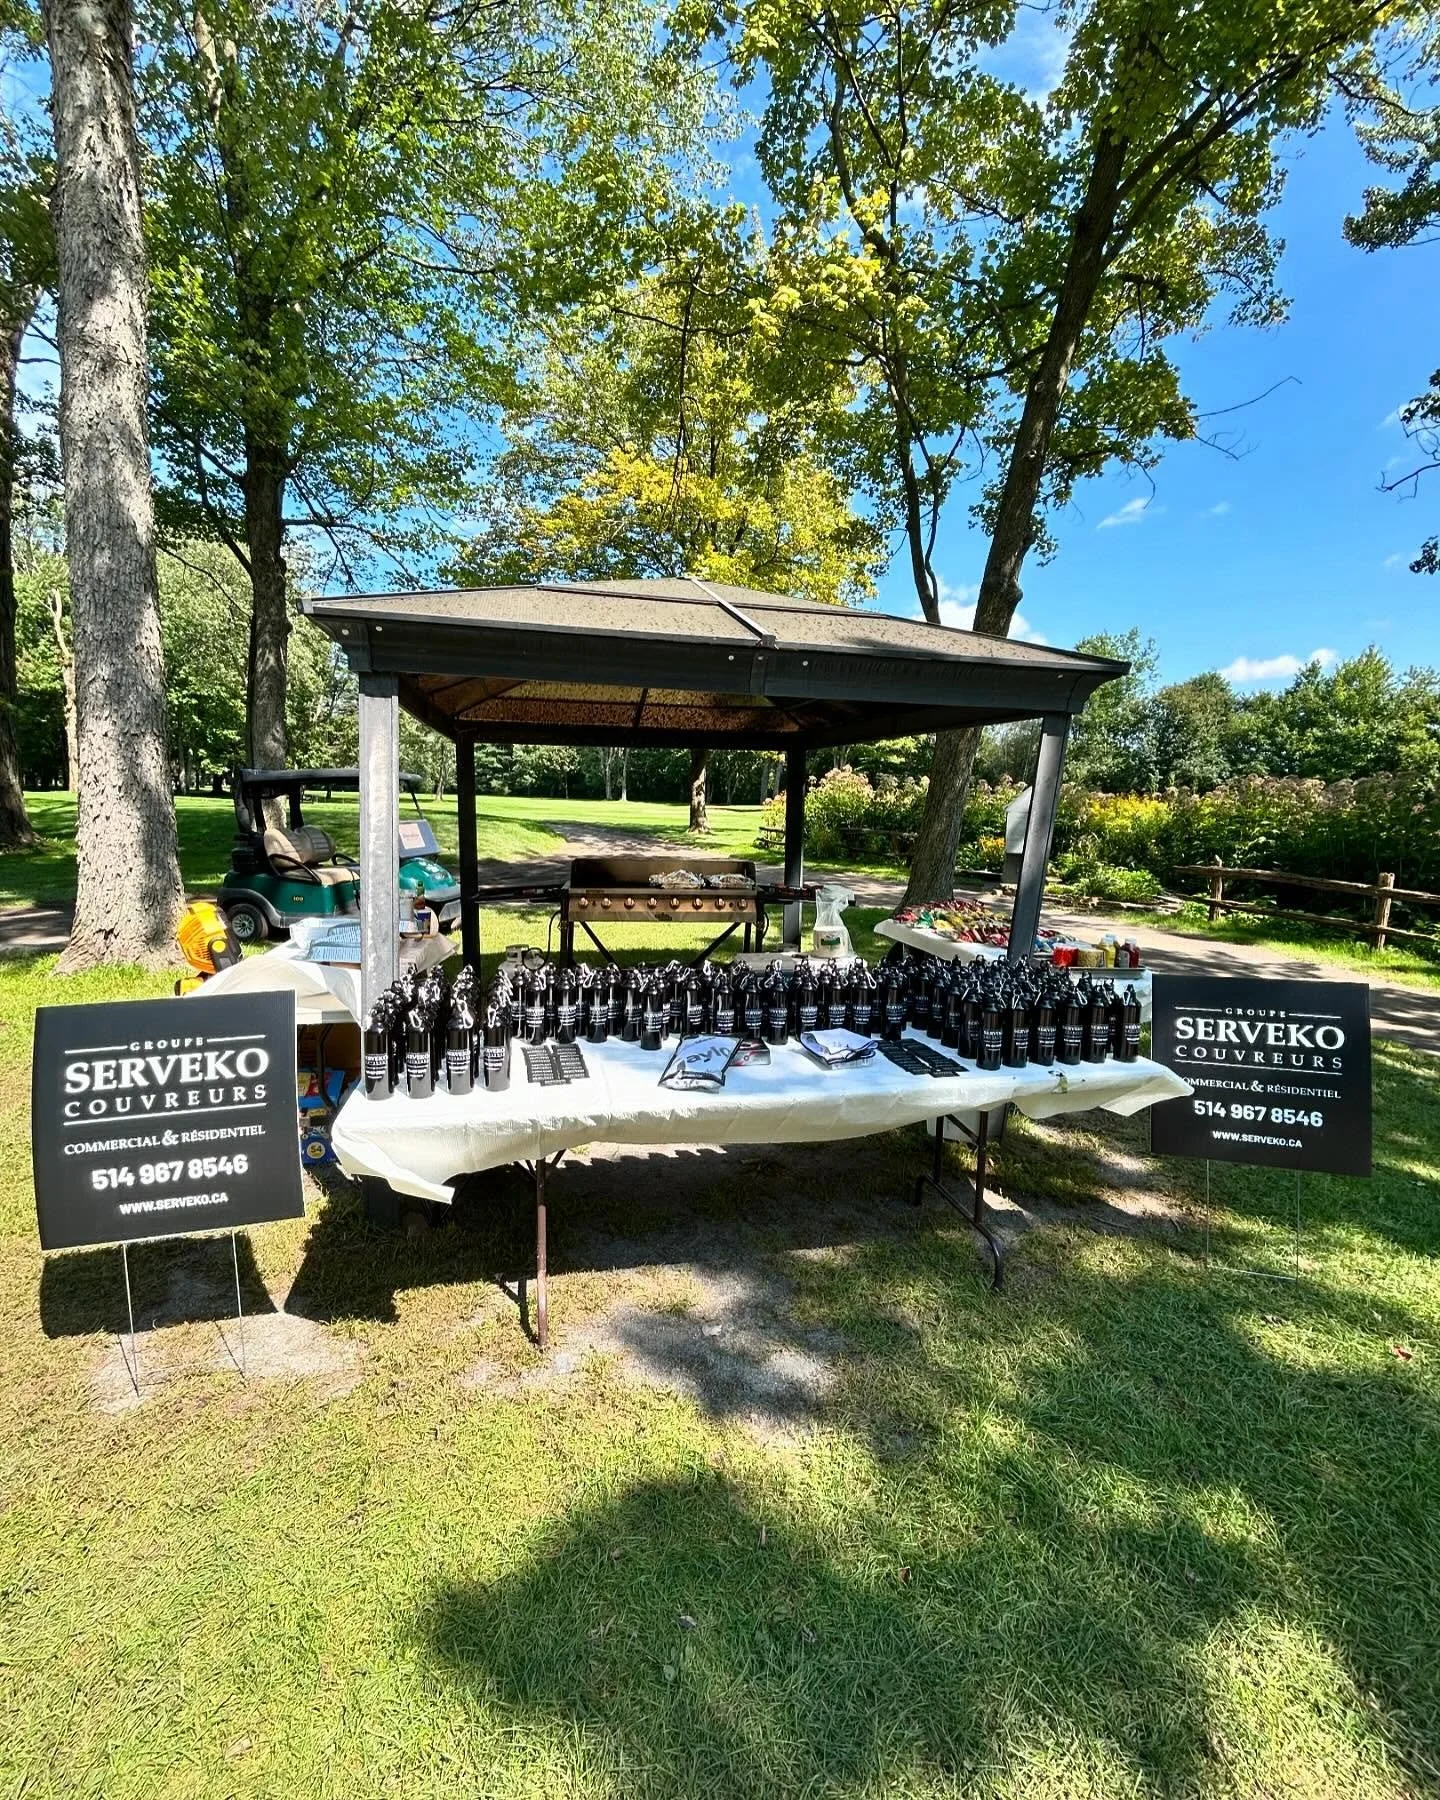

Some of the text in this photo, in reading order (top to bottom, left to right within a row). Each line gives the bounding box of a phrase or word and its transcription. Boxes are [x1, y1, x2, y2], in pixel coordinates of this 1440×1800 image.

[1225, 1007, 1287, 1018] GROUPE
[129, 1037, 204, 1052] GROUPE
[1175, 1016, 1345, 1050] SERVEKO
[1175, 1045, 1343, 1069] COUVREURS
[64, 1047, 270, 1094] SERVEKO
[64, 1084, 268, 1118] COUVREURS
[1182, 1077, 1342, 1099] OMMERCIAL & RÉSIDENTIEL
[1193, 1100, 1324, 1128] 514 967 8546
[64, 1124, 266, 1156] COMMERCIAL & RÉSIDENTIEL
[1211, 1130, 1303, 1149] WWW.SERVEKO.CA
[91, 1153, 249, 1191] 514 967 8546
[119, 1191, 229, 1216] WWW.SERVEKO.CA
